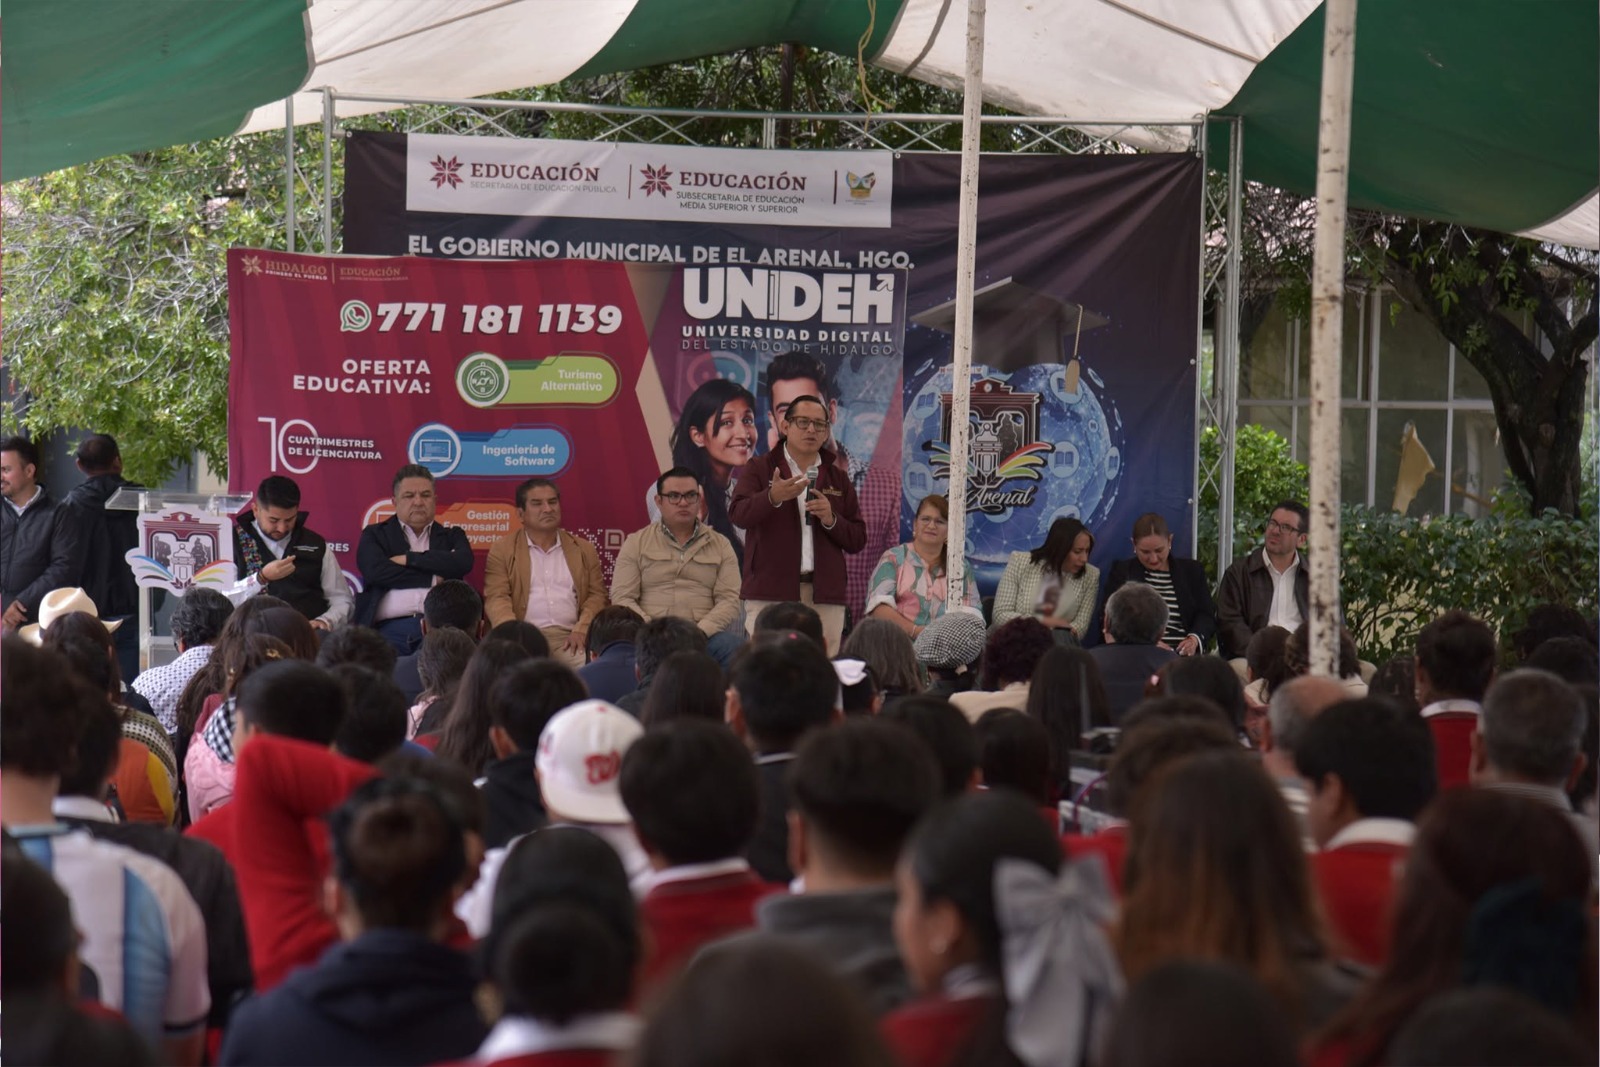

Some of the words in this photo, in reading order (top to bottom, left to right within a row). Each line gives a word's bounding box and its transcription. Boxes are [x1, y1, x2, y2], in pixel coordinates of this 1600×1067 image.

[470, 162, 600, 182] EDUCACIÓN
[679, 171, 807, 191] EDUCACIÓN
[742, 194, 753, 203] DE
[680, 201, 707, 210] MEDIA
[708, 202, 749, 212] SUPERIOR
[751, 204, 756, 212] Y
[758, 205, 798, 214] SUPERIOR
[408, 235, 433, 254] EL
[439, 237, 560, 258] GOBIERNO
[566, 241, 686, 263] MUNICIPAL
[693, 246, 720, 264] DE
[727, 247, 751, 264] EL
[757, 248, 852, 269] ARENAL,
[859, 250, 915, 269] HGO.
[265, 260, 328, 276] HIDALGO
[340, 266, 401, 277] EDUCACIÓN
[377, 303, 446, 332] 771
[462, 305, 523, 334] 181
[538, 303, 622, 334] 1139
[682, 325, 810, 342] UNIVERSIDAD
[818, 330, 893, 343] DIGITAL
[682, 339, 710, 350] DEL
[720, 339, 782, 352] ESTADO
[792, 342, 811, 354] DE
[820, 344, 893, 356] HIDALGO
[342, 359, 431, 375] OFERTA
[558, 369, 603, 380] Turismo
[293, 374, 431, 394] EDUCATIVA:
[540, 381, 603, 392] Alternativo
[257, 416, 320, 475] 10
[287, 435, 375, 448] CUATRIMESTRES
[288, 447, 303, 456] DE
[305, 448, 383, 460] LICENCIATURA
[540, 444, 556, 455] de
[504, 456, 556, 466] Software
[466, 510, 510, 520] Gestión
